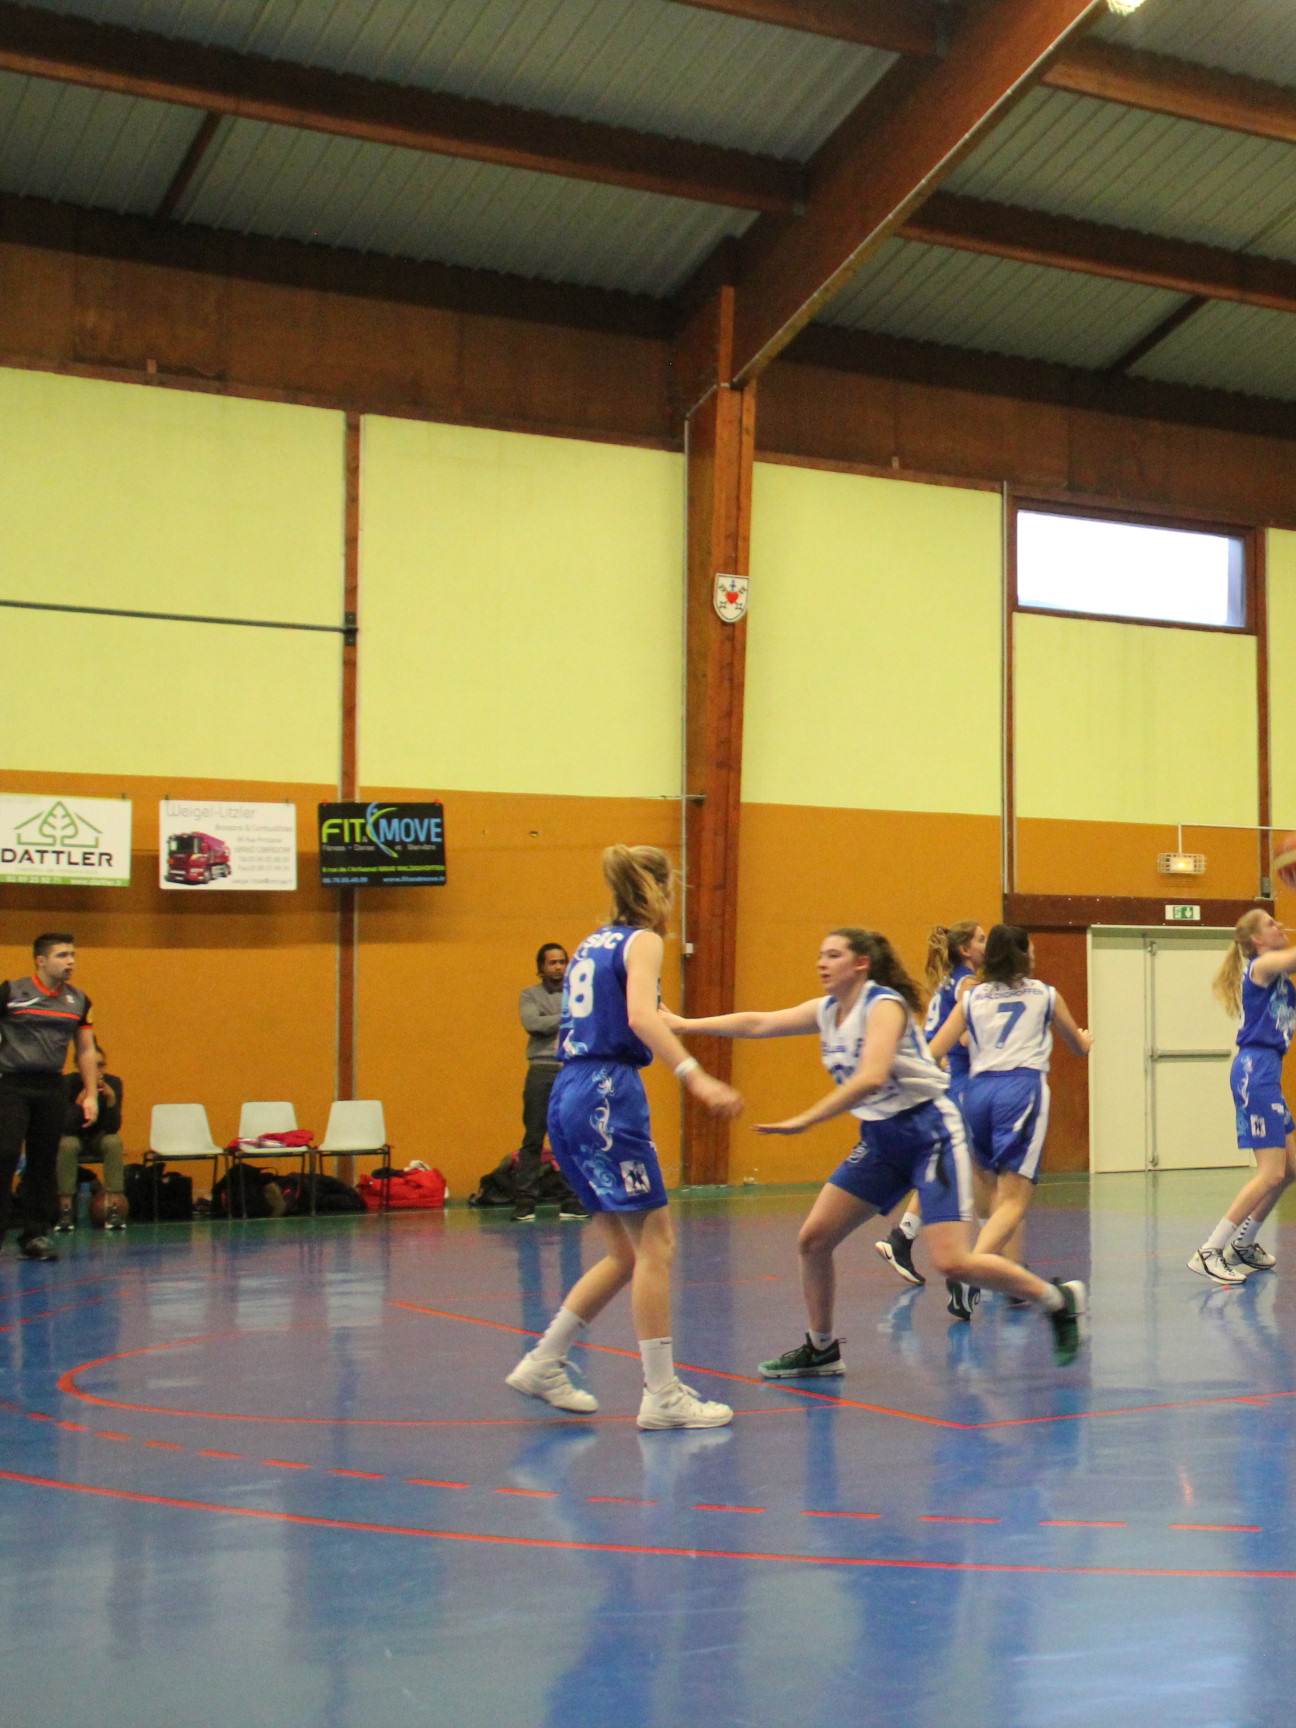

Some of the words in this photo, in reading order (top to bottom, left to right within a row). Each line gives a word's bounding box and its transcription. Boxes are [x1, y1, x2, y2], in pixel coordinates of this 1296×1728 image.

[322, 818, 365, 843] FIT
[379, 818, 443, 842] MOVE
[1, 848, 113, 867] DATTLER
[581, 931, 624, 949] SBC
[568, 957, 597, 1018] 8
[995, 1001, 1027, 1049] 7
